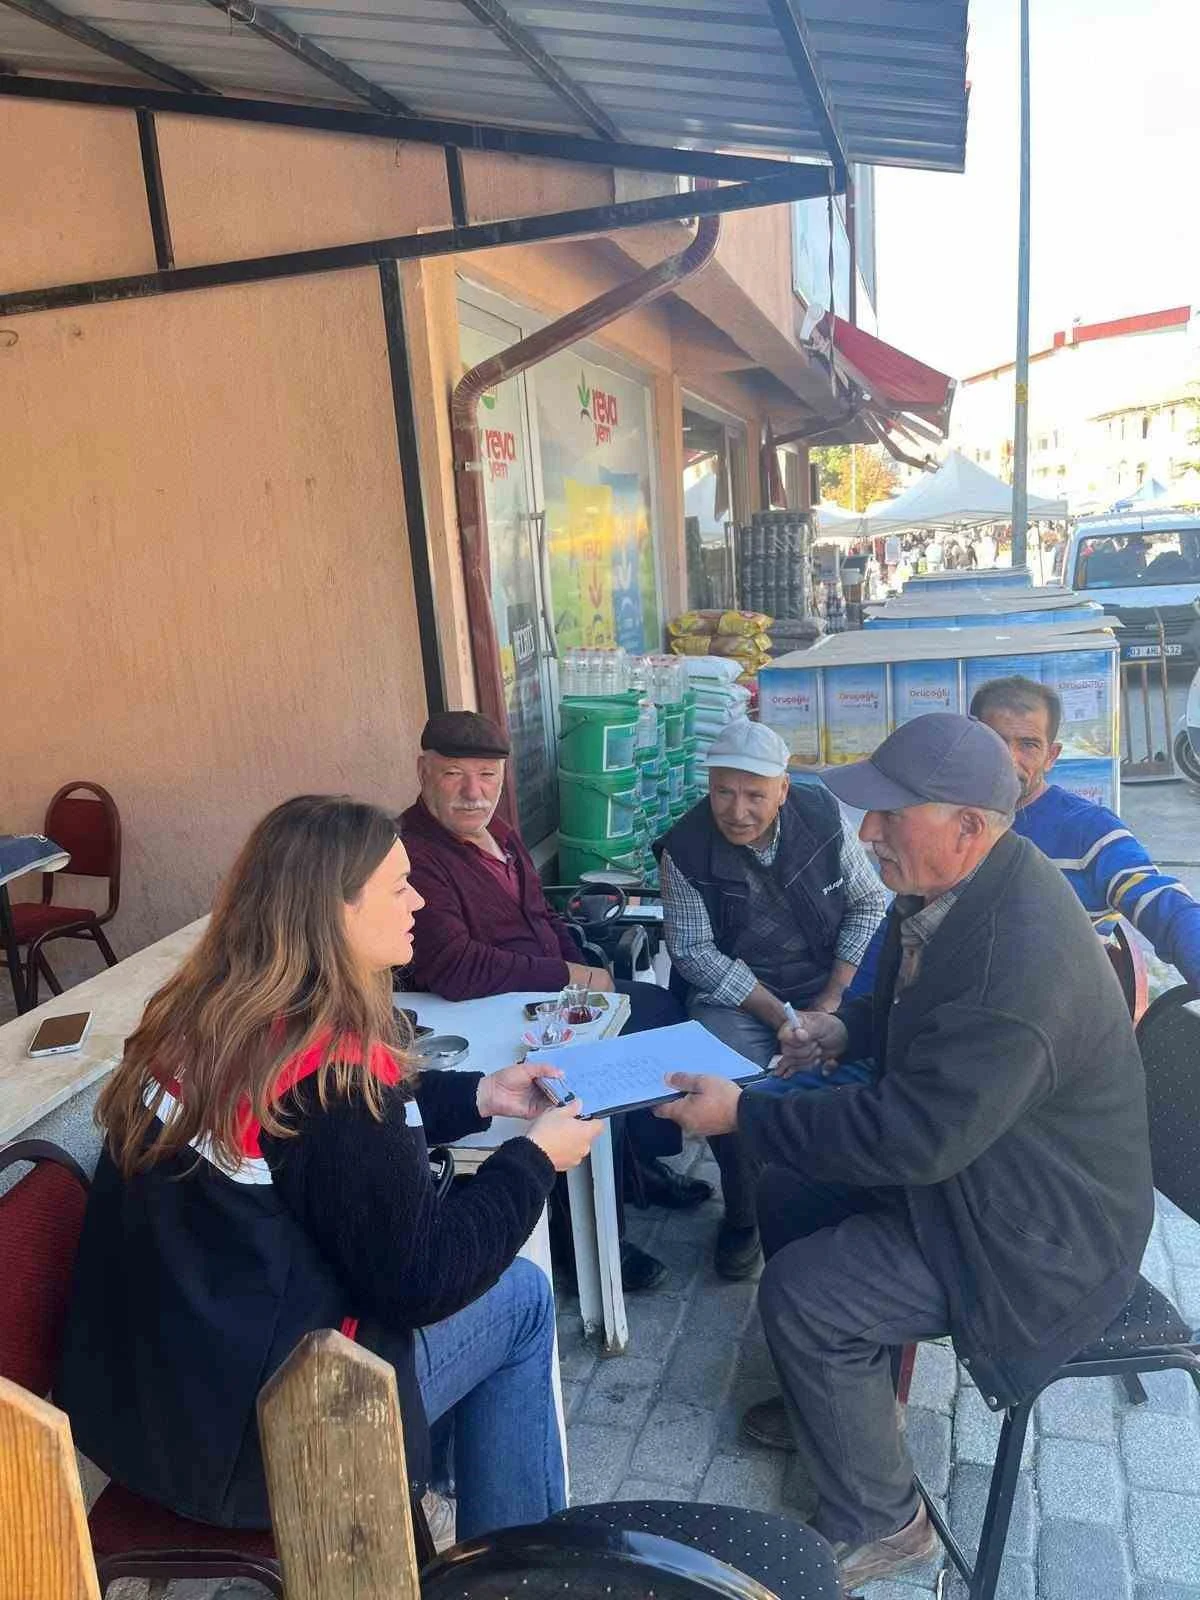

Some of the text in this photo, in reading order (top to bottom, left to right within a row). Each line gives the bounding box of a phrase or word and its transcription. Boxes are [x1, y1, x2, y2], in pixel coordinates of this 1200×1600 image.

[592, 388, 618, 426] reva
[485, 429, 516, 461] reva
[594, 424, 612, 446] yem
[489, 461, 508, 482] yem
